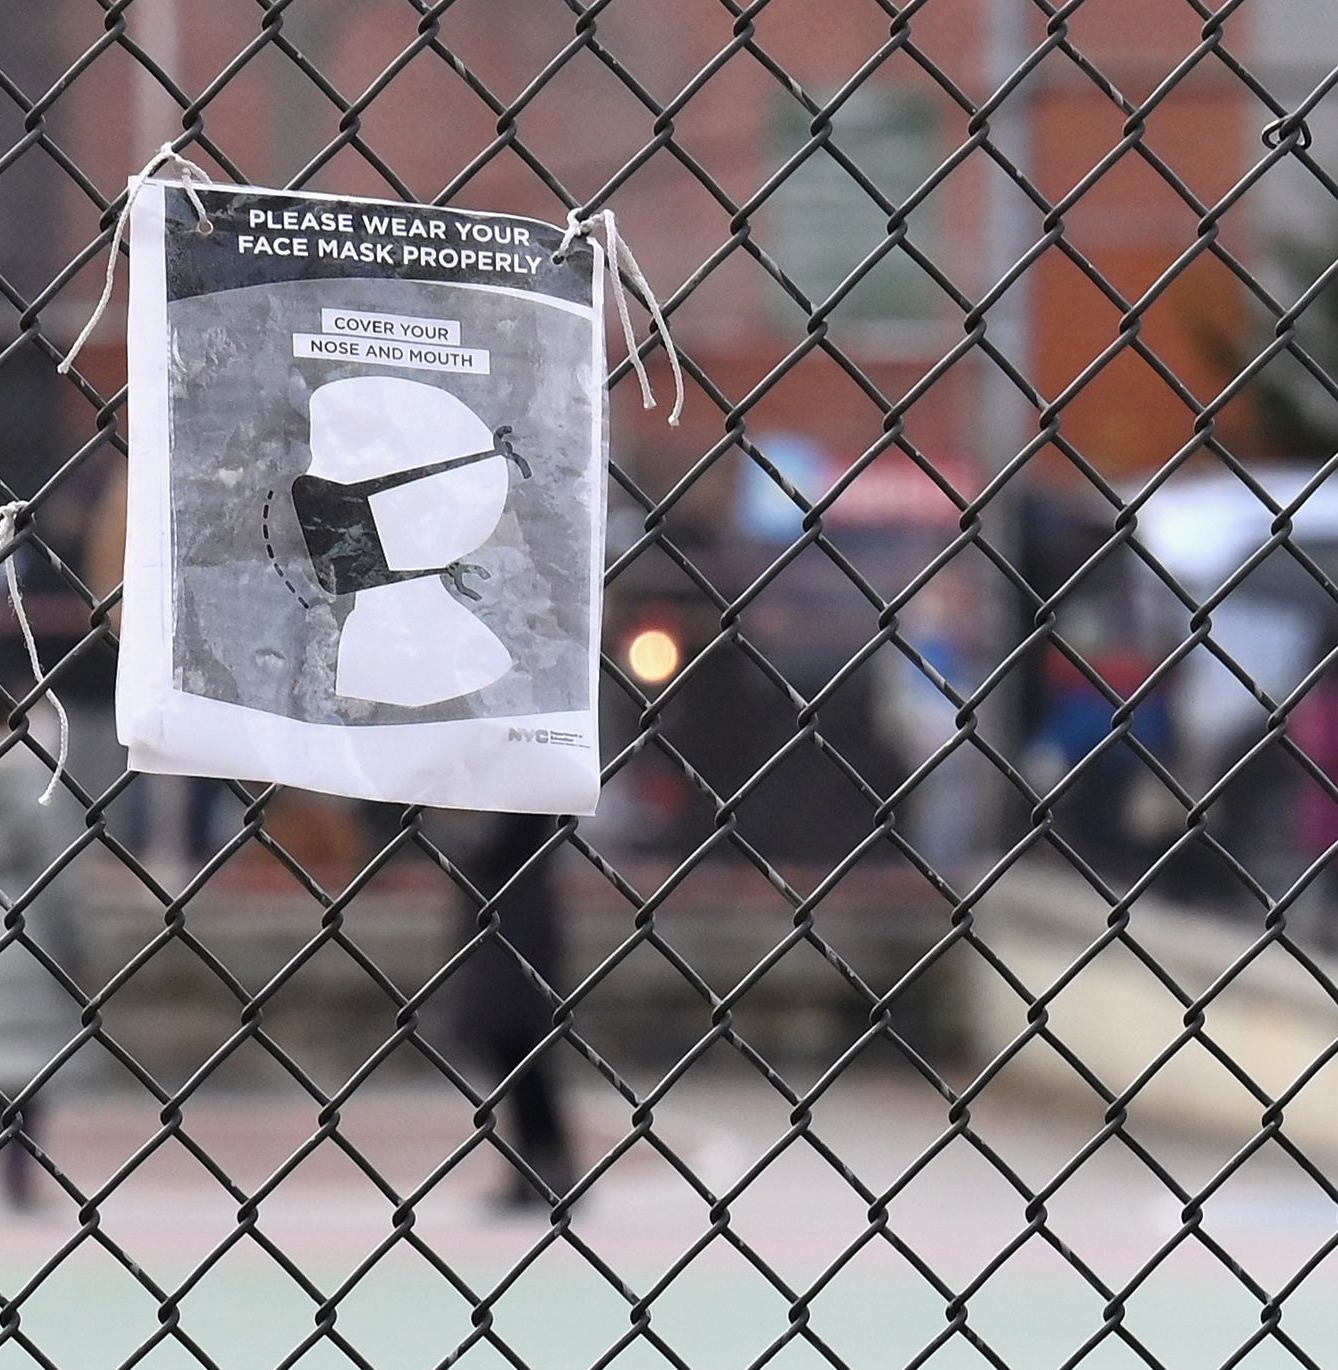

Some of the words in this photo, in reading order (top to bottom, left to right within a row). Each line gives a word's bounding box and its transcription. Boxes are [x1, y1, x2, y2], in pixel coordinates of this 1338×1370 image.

[249, 209, 354, 233] PLEASE
[362, 216, 446, 239] WEAR
[455, 222, 530, 246] YOUR
[238, 236, 309, 257] FACE
[319, 239, 394, 264] MASK
[403, 246, 542, 274] PROPERLY
[334, 317, 395, 335] COVER
[400, 323, 449, 341] YOUR
[311, 340, 359, 356] NOSE
[366, 345, 403, 361] AND
[410, 350, 473, 367] MOUTH
[508, 727, 549, 744] NYC
